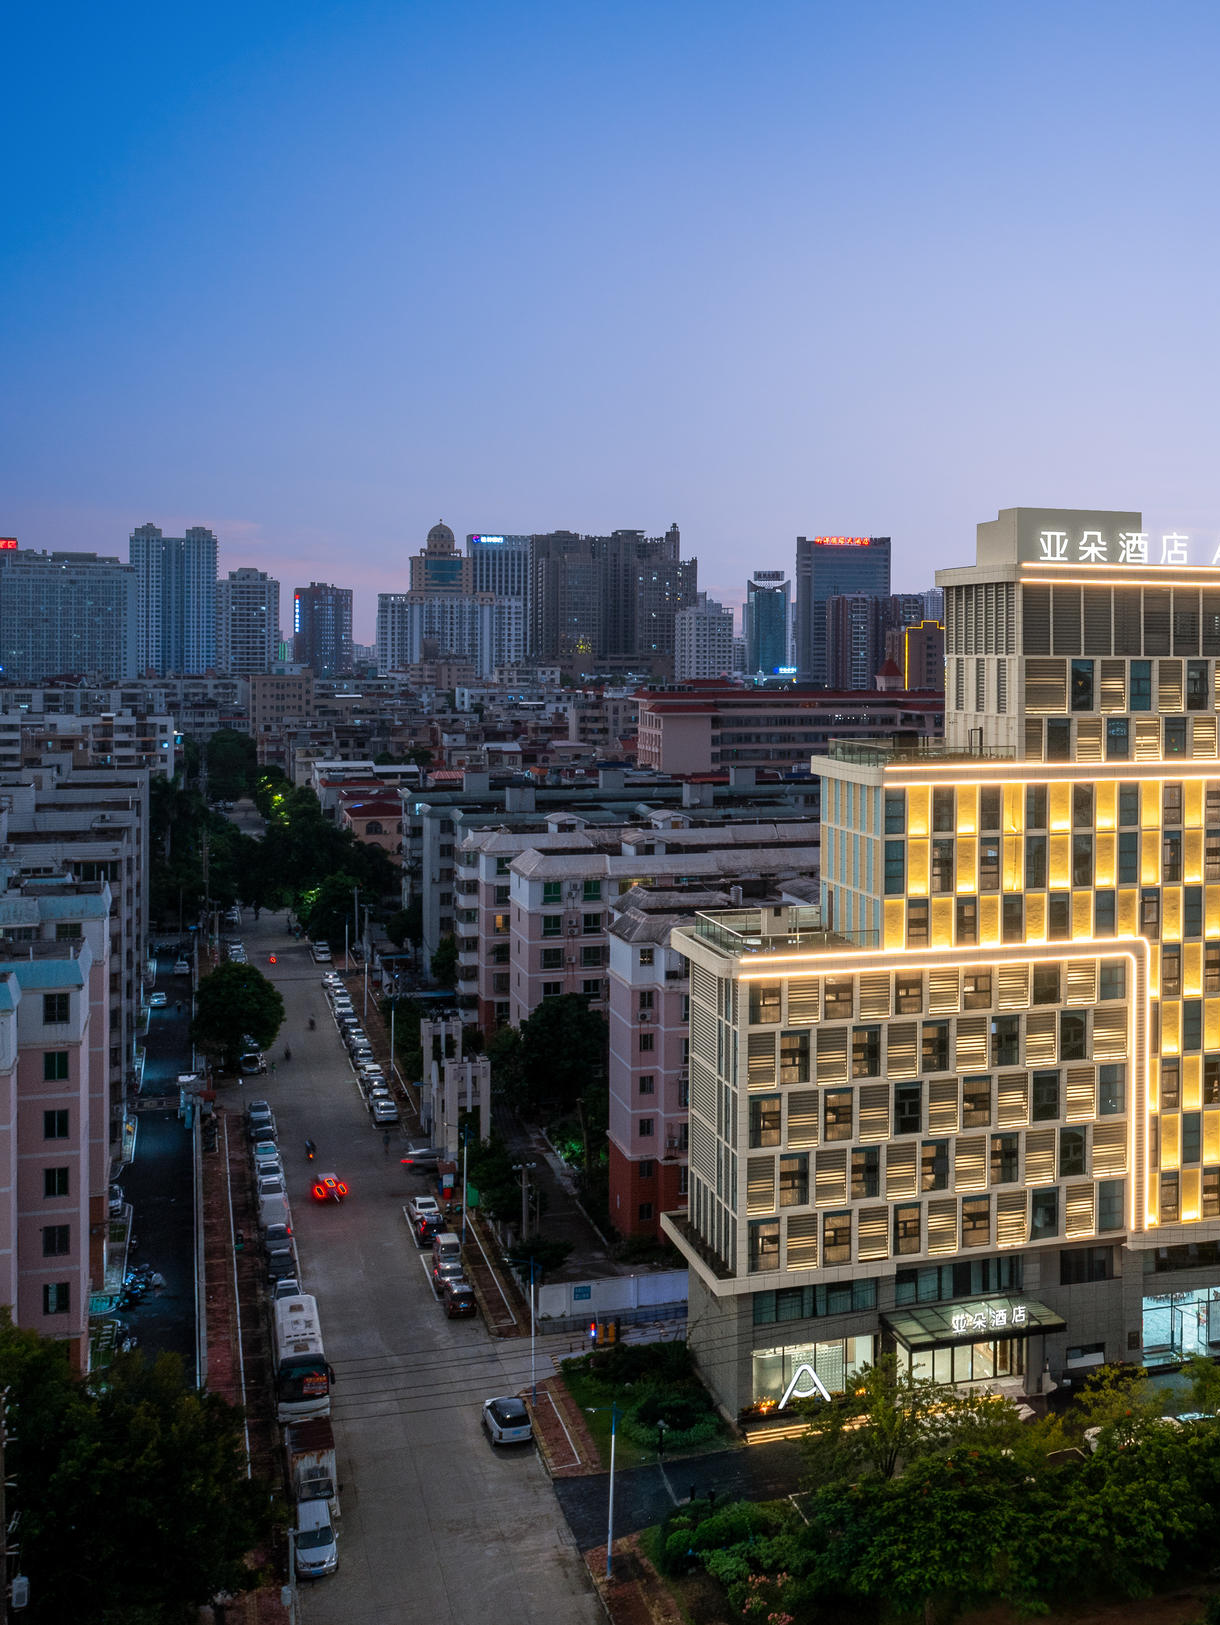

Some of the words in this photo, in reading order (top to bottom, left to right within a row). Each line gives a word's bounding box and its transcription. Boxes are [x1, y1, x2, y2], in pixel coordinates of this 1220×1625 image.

[1039, 530, 1189, 564] 亚朵酒店
[952, 1305, 1027, 1334] 亚朵酒店
